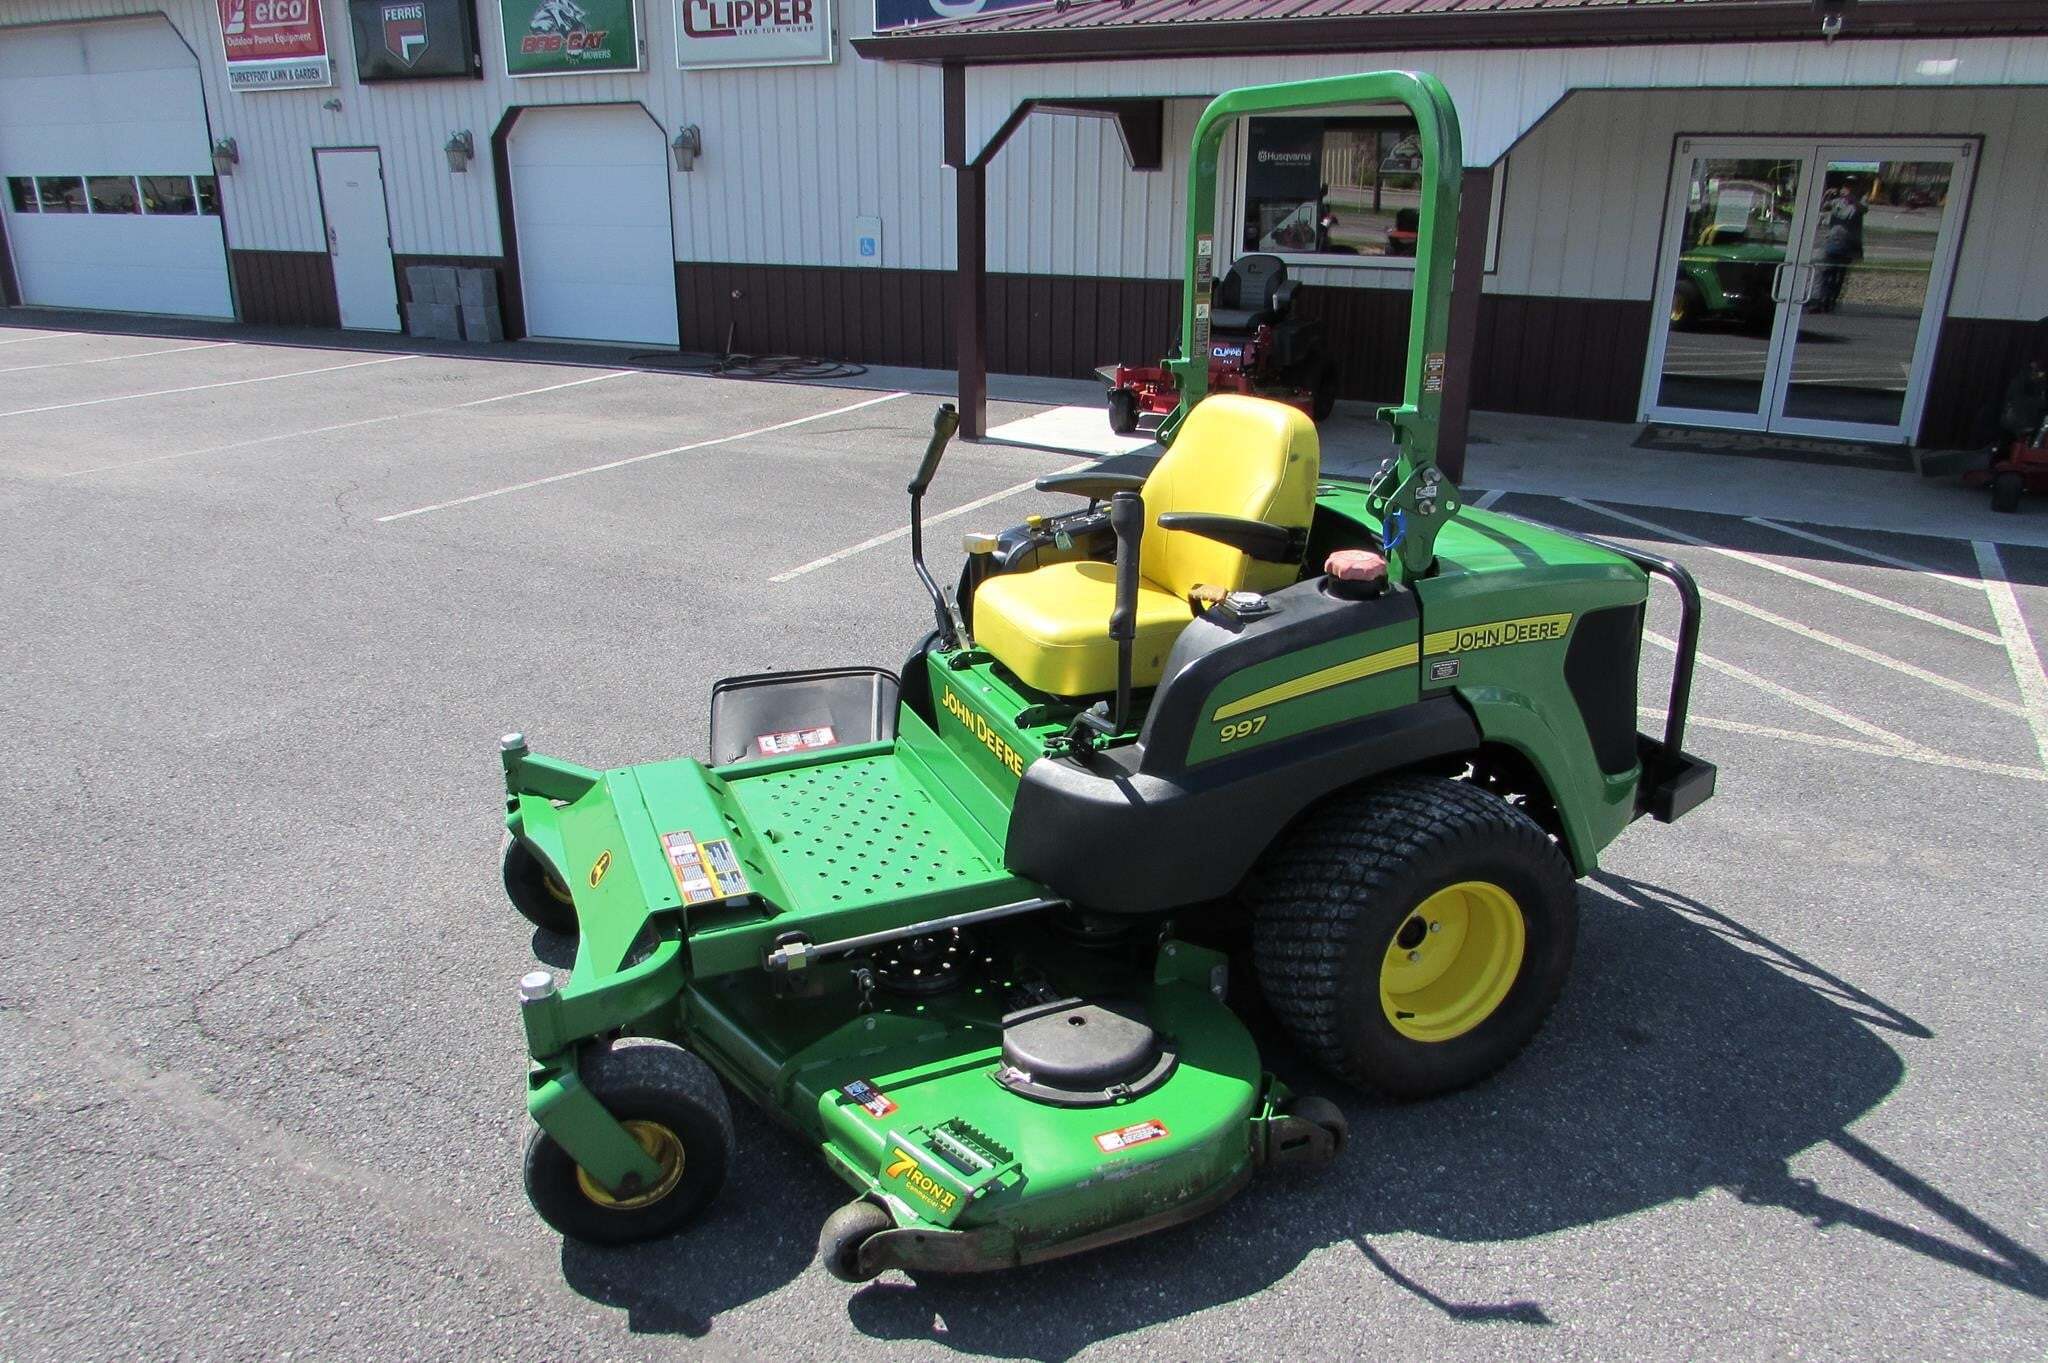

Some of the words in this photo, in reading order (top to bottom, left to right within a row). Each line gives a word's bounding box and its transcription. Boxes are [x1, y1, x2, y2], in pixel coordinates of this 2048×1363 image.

[384, 6, 422, 21] FERRIS
[683, 0, 813, 38] CLIPPER
[226, 36, 254, 47] Outdoor
[254, 35, 274, 45] Power
[274, 32, 312, 46] Equipment
[582, 49, 612, 59] MOWERS
[294, 66, 321, 81] GARDEN
[1267, 151, 1311, 162] Husqvarna
[1448, 628, 1500, 654] JOHN
[1504, 621, 1561, 646] DEERE
[942, 684, 975, 733] JOHN
[977, 713, 1023, 778] DEERE
[1220, 715, 1267, 743] 997
